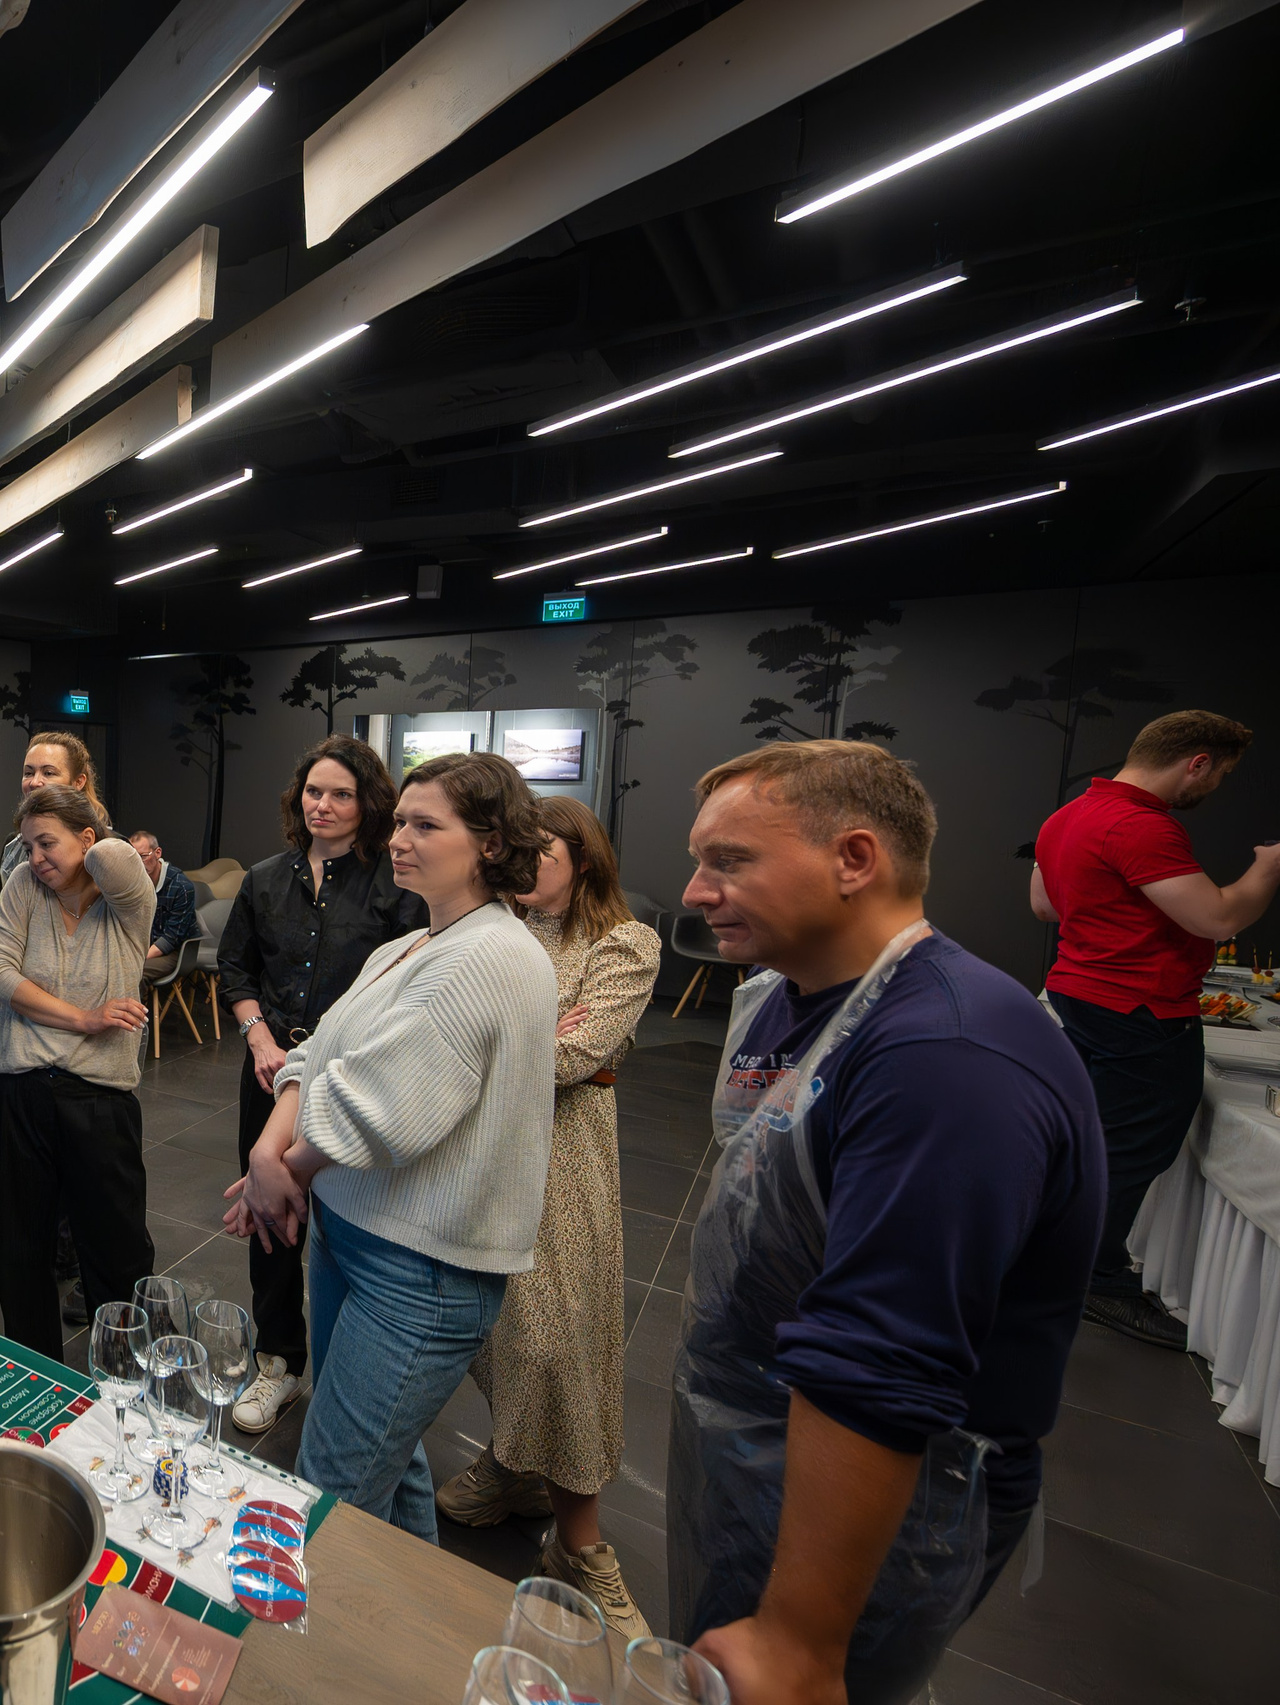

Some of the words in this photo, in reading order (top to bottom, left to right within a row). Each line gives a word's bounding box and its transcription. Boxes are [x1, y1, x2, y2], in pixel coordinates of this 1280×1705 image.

[549, 602, 580, 611] ВЫХОД
[553, 610, 574, 618] EXIT
[1, 1388, 30, 1410] Мерло
[28, 1399, 66, 1426] Каберне
